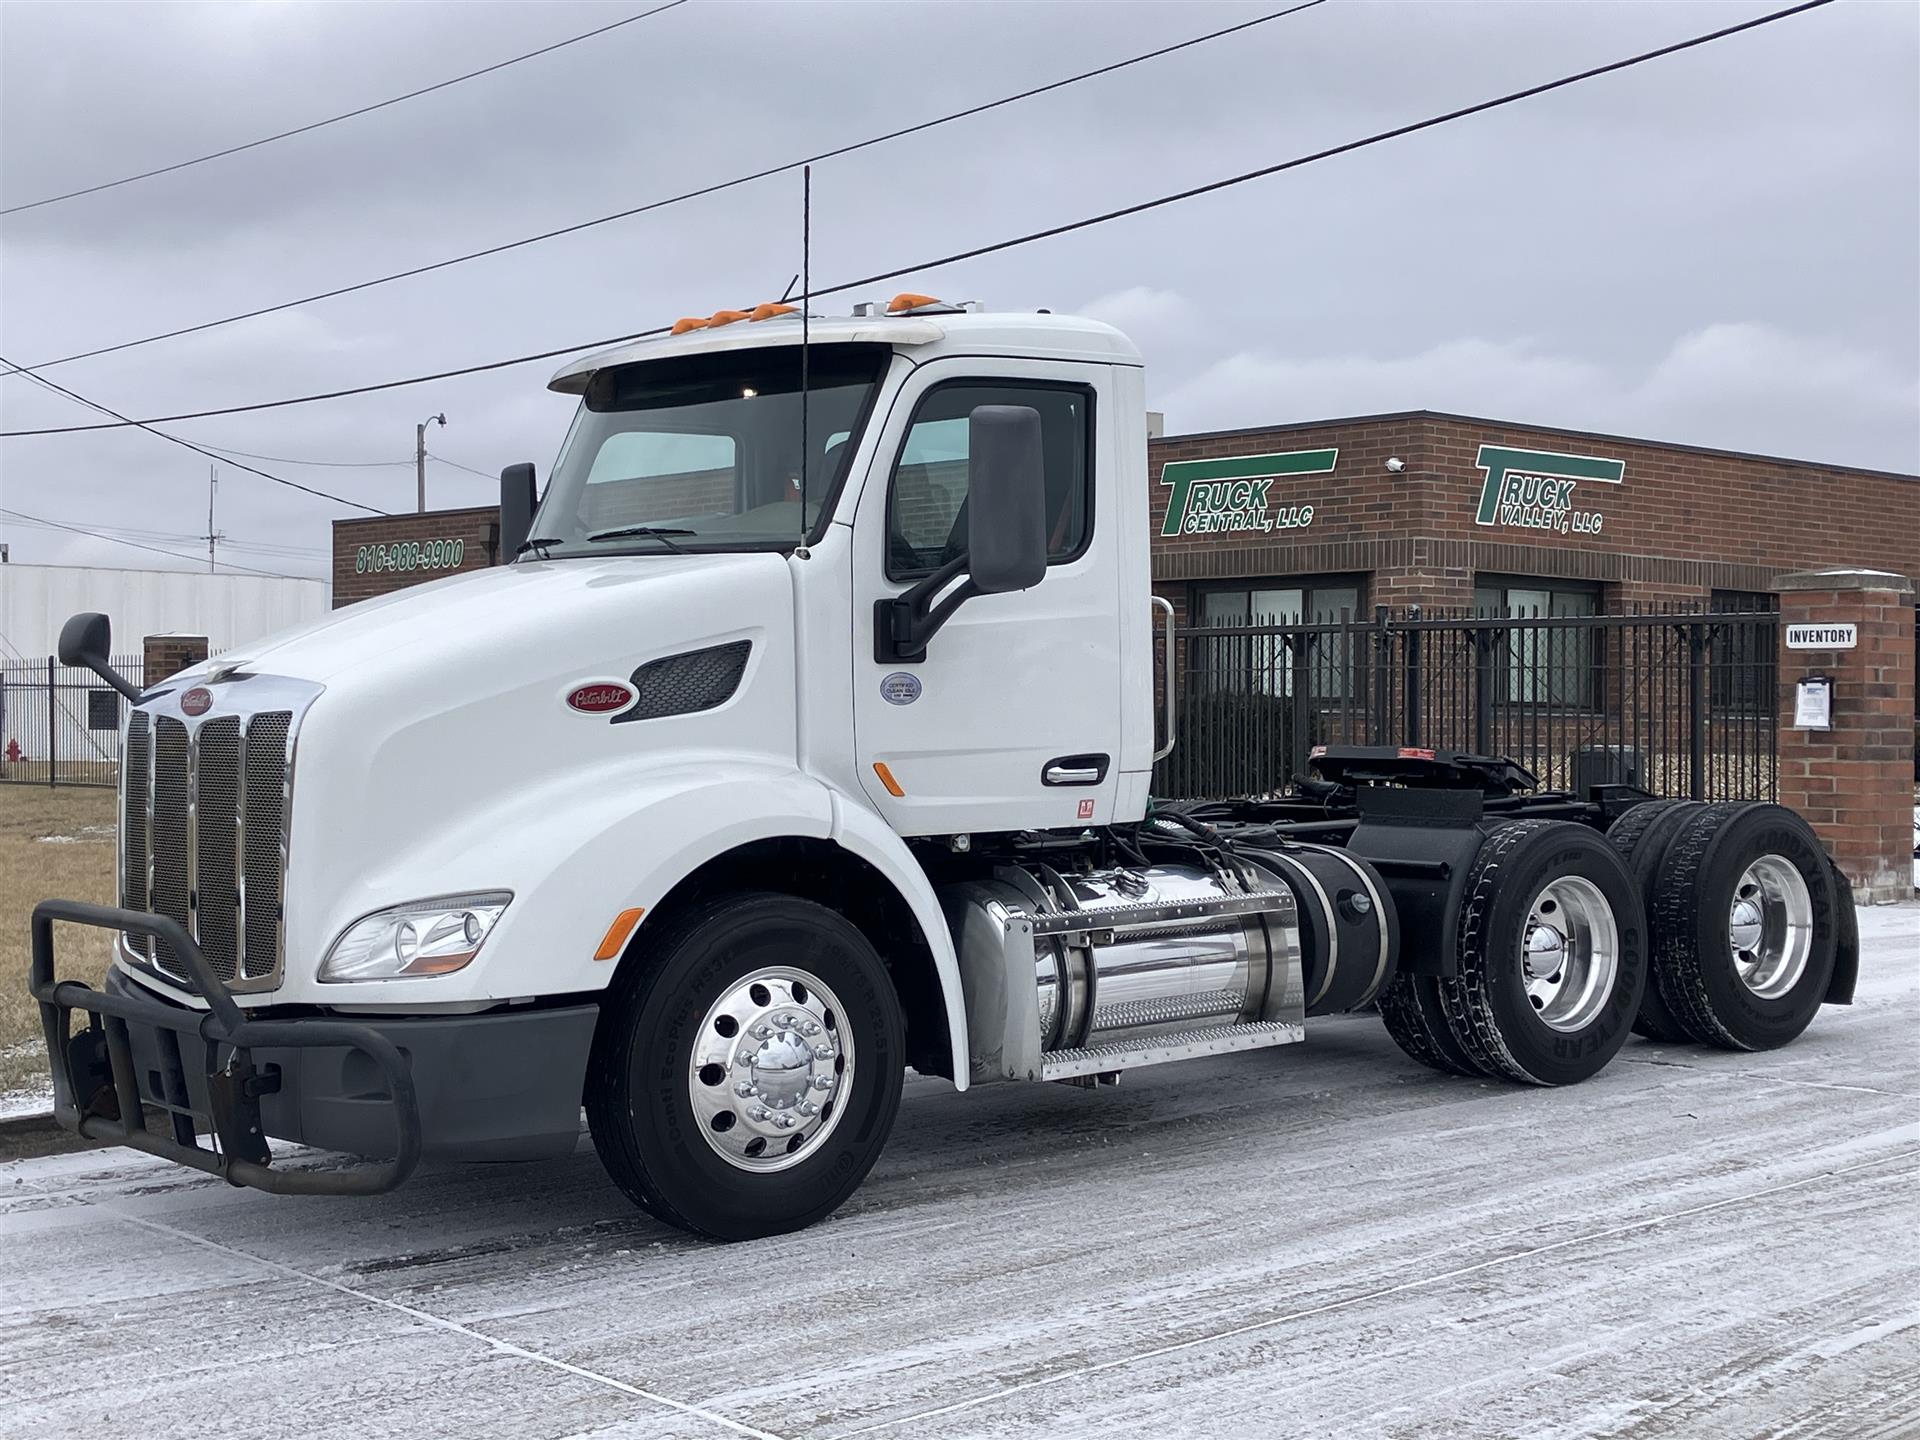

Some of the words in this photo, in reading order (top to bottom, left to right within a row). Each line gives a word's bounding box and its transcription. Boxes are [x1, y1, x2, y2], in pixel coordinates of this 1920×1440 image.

[1160, 447, 1339, 537] TRUCK
[1475, 444, 1626, 526] TRUCK
[1184, 508, 1273, 534] CENTRAL,
[1276, 505, 1314, 529] LLC
[1501, 504, 1570, 535] VALLEY,
[1572, 511, 1603, 534] LLC
[355, 538, 464, 574] 816-988-9900
[1789, 629, 1853, 643] INVENTORY
[575, 689, 626, 707] Peterbilt
